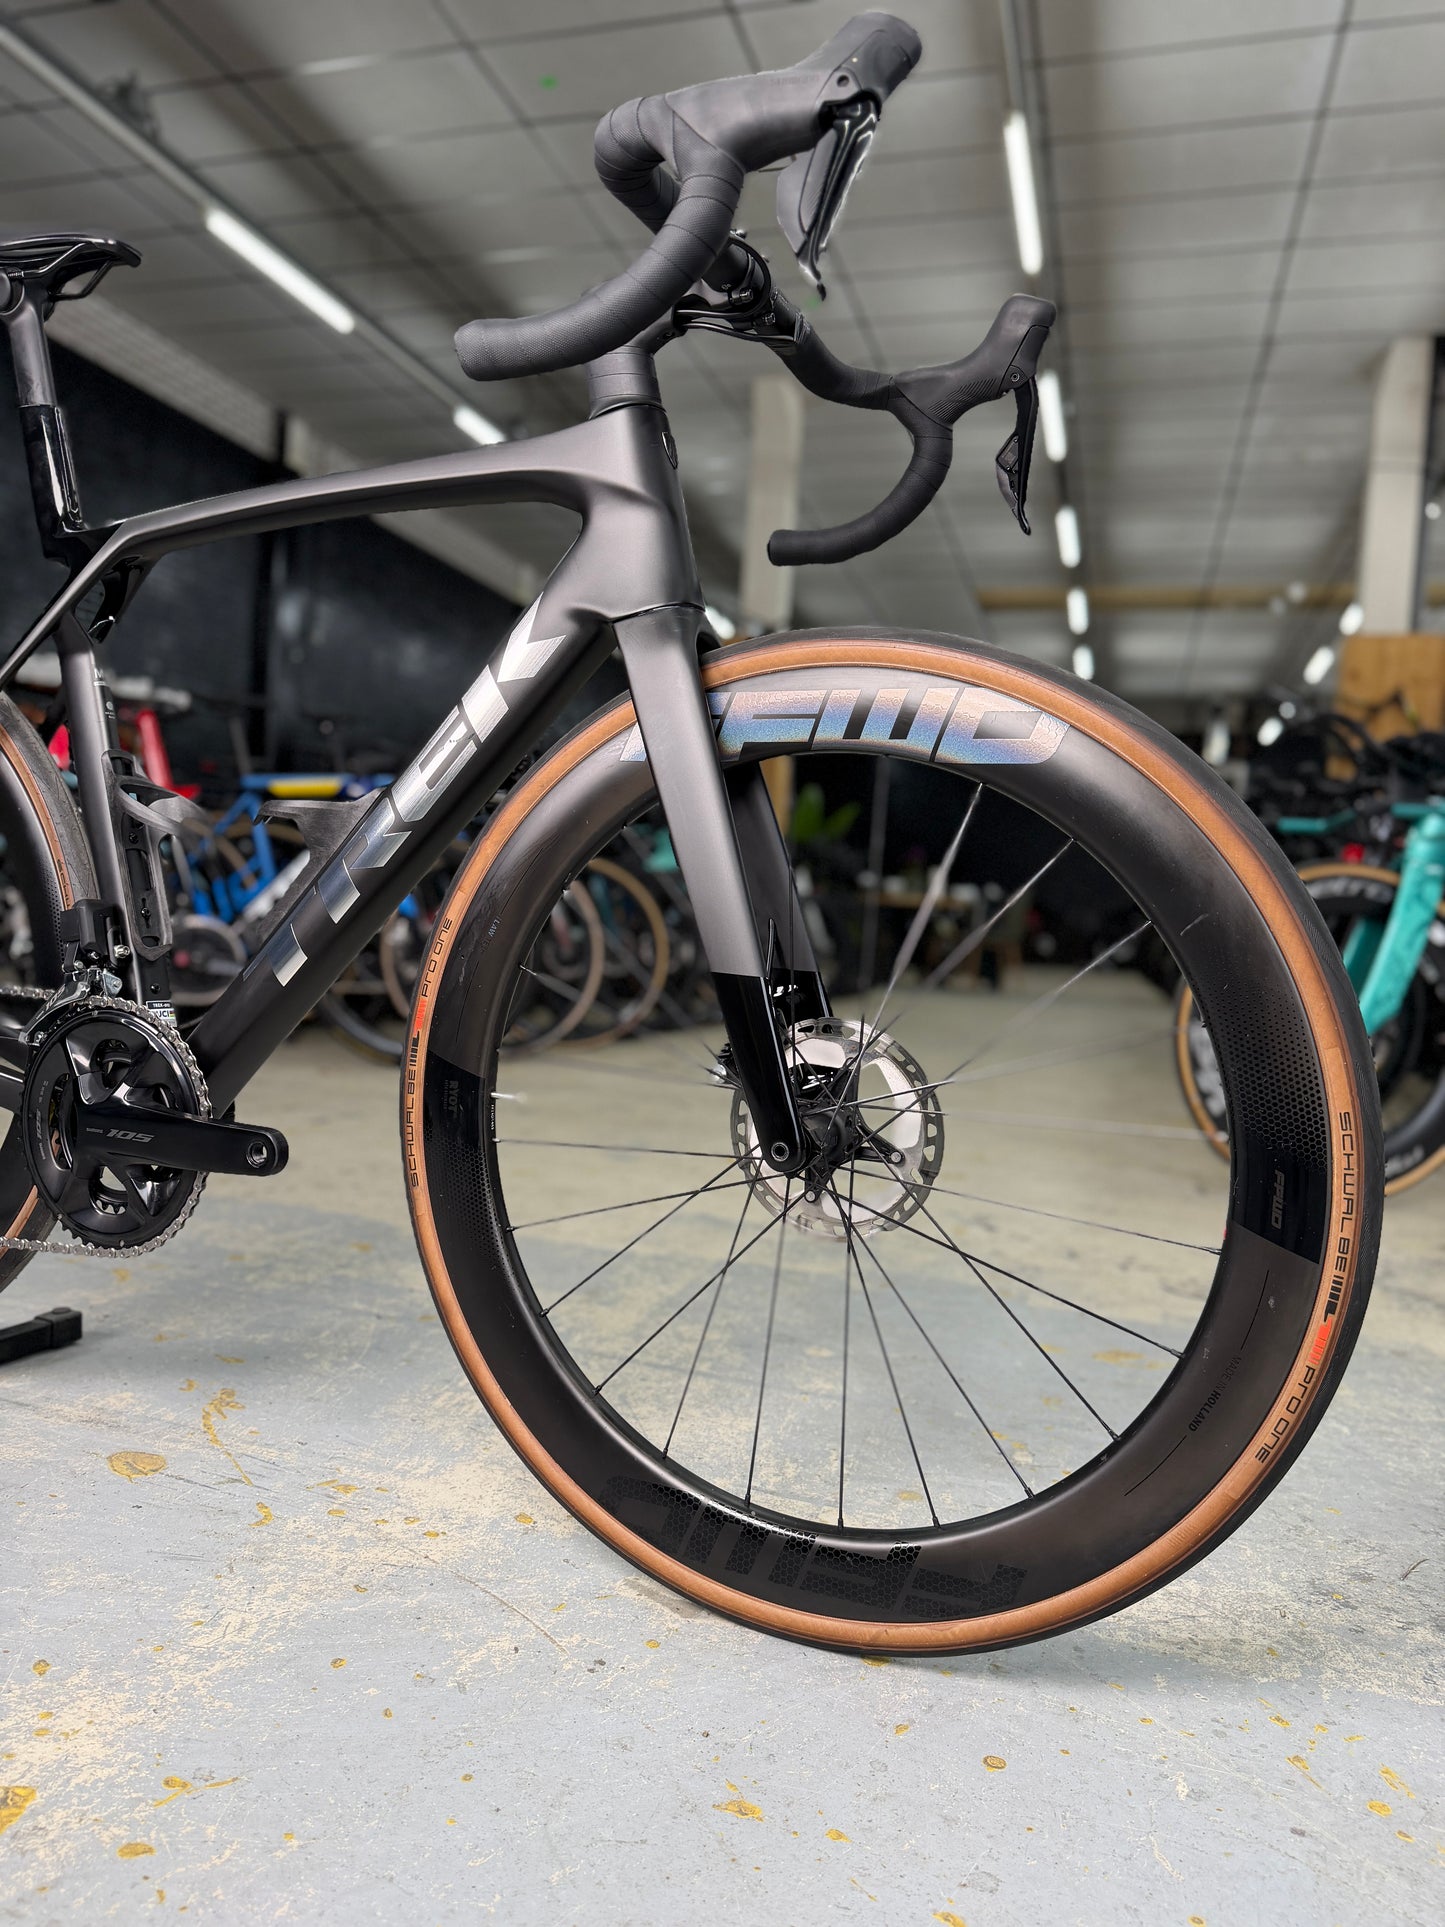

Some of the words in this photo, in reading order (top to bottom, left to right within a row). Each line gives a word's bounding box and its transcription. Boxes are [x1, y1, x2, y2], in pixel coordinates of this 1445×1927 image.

[620, 687, 1071, 764] FWD
[242, 592, 566, 988] TREK
[406, 1070, 419, 1187] SCHWALBE
[422, 959, 437, 998] PRO
[434, 917, 453, 956] ONE
[106, 1128, 155, 1143] 105
[1271, 1169, 1285, 1230] FFWD
[1336, 1112, 1354, 1272] SCHWALBE
[1188, 1390, 1221, 1432] HOLLAND
[1285, 1365, 1316, 1415] PRO
[1255, 1418, 1289, 1464] ONE
